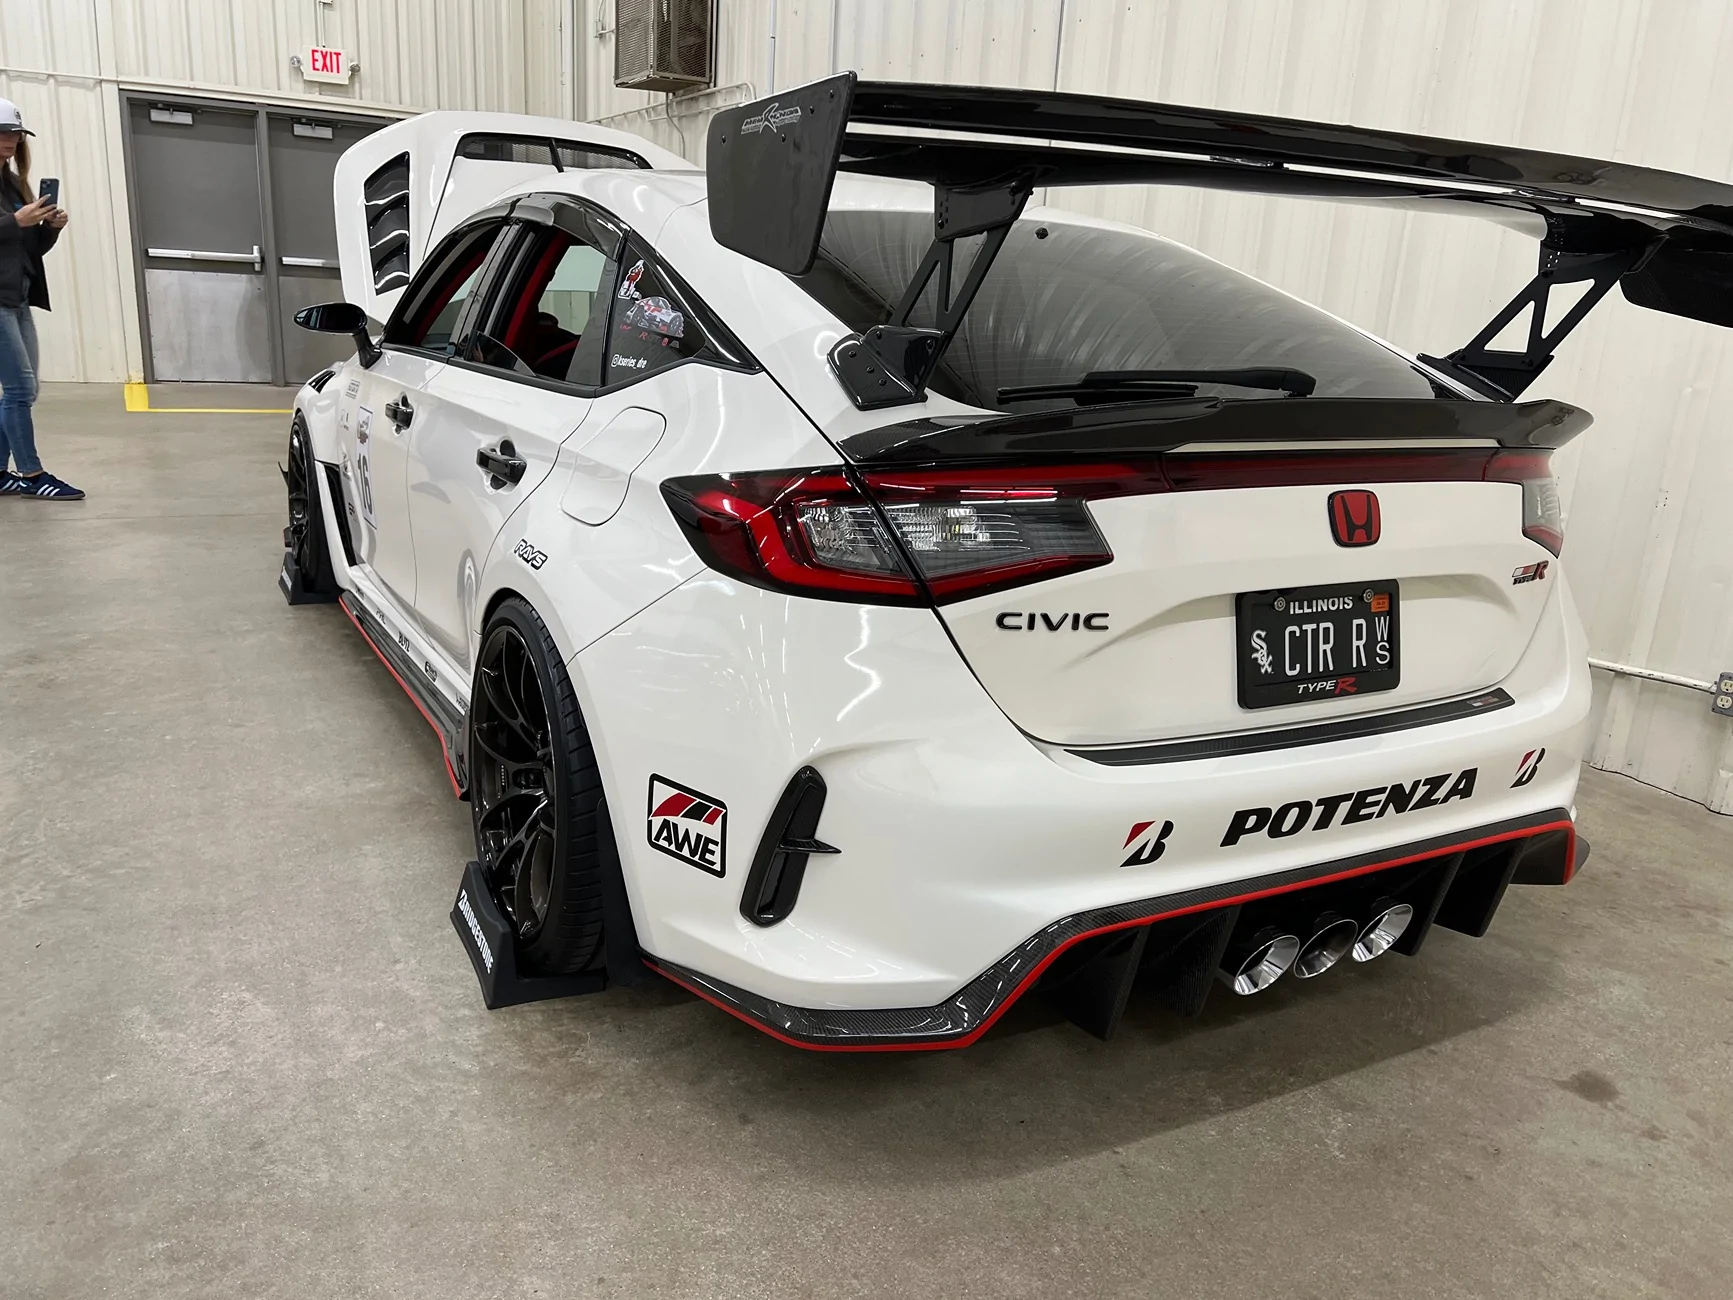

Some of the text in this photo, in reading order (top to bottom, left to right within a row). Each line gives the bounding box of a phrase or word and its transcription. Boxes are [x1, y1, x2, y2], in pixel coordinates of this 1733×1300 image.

[311, 49, 342, 74] EXIT
[358, 453, 373, 515] 16
[514, 538, 548, 570] RAYS
[996, 611, 1110, 631] CIVIC
[1289, 596, 1354, 615] ILLINOIS
[1284, 618, 1367, 677] CTR R
[1297, 679, 1336, 694] TYPE
[1219, 767, 1479, 847] POTENZA
[653, 818, 720, 867] AWE
[458, 888, 494, 975] BRIDGESTONE
